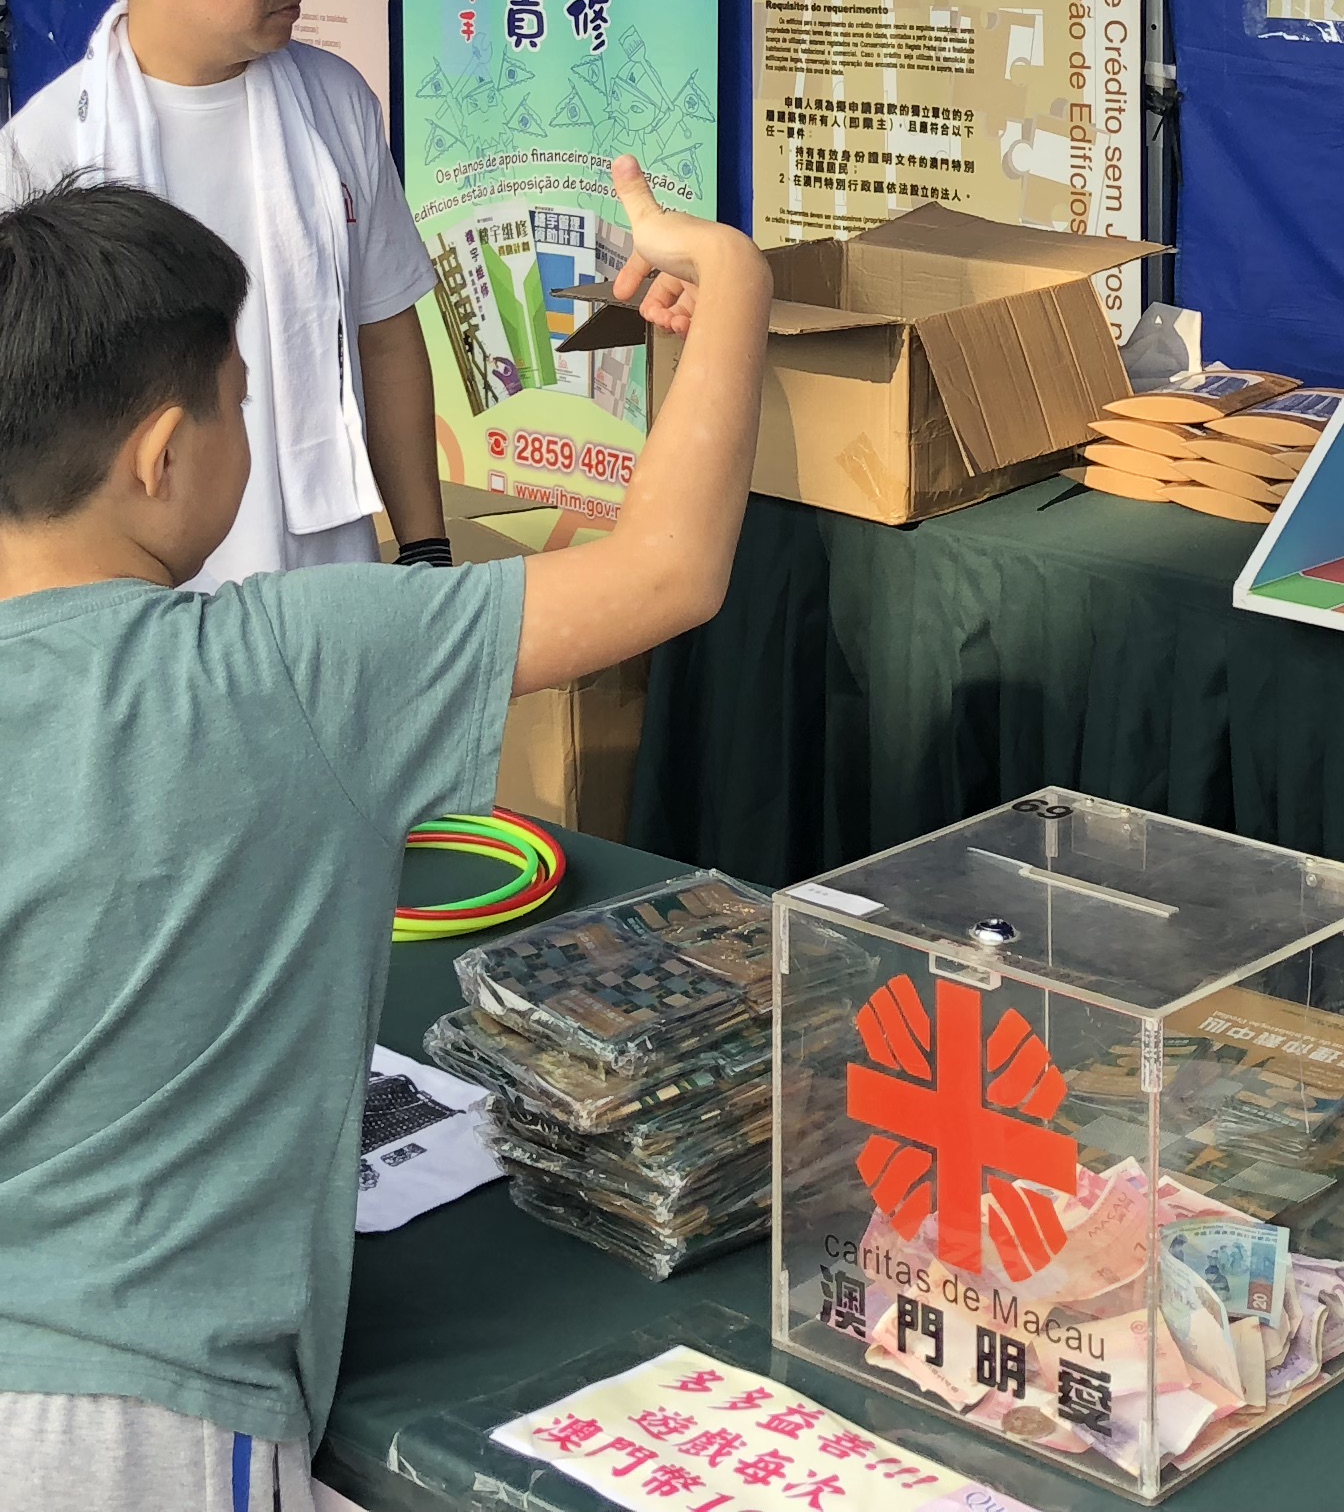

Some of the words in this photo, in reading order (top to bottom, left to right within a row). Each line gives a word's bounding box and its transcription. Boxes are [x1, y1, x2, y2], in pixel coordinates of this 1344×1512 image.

[766, 0, 809, 12] Requisitos
[811, 2, 821, 12] do
[823, 3, 889, 15] requerimento
[1068, 50, 1090, 90] de
[1103, 20, 1128, 135] Crédito
[414, 196, 460, 224] edifícios
[461, 186, 488, 205] estão
[497, 176, 560, 196] disposição
[562, 175, 577, 190] de
[579, 178, 609, 195] todos
[436, 170, 451, 184] Os
[454, 161, 484, 183] planos
[485, 154, 498, 168] de
[499, 149, 528, 170] apoio
[531, 148, 589, 164] financeiro
[591, 155, 612, 172] para
[677, 183, 693, 201] de
[1068, 103, 1092, 235] Edifícios
[1103, 146, 1123, 213] sem
[1105, 223, 1128, 310] Jos
[516, 434, 574, 470] 2859
[581, 447, 633, 483] 4875
[824, 1233, 932, 1294] caritas
[942, 1274, 981, 1313] de
[992, 1287, 1106, 1362] Macau
[1252, 1292, 1268, 1310] 20
[819, 1264, 1113, 1438] 澳門明愛
[532, 1414, 763, 1512] 澳門幣1
[628, 1406, 846, 1511] 遊戲每次
